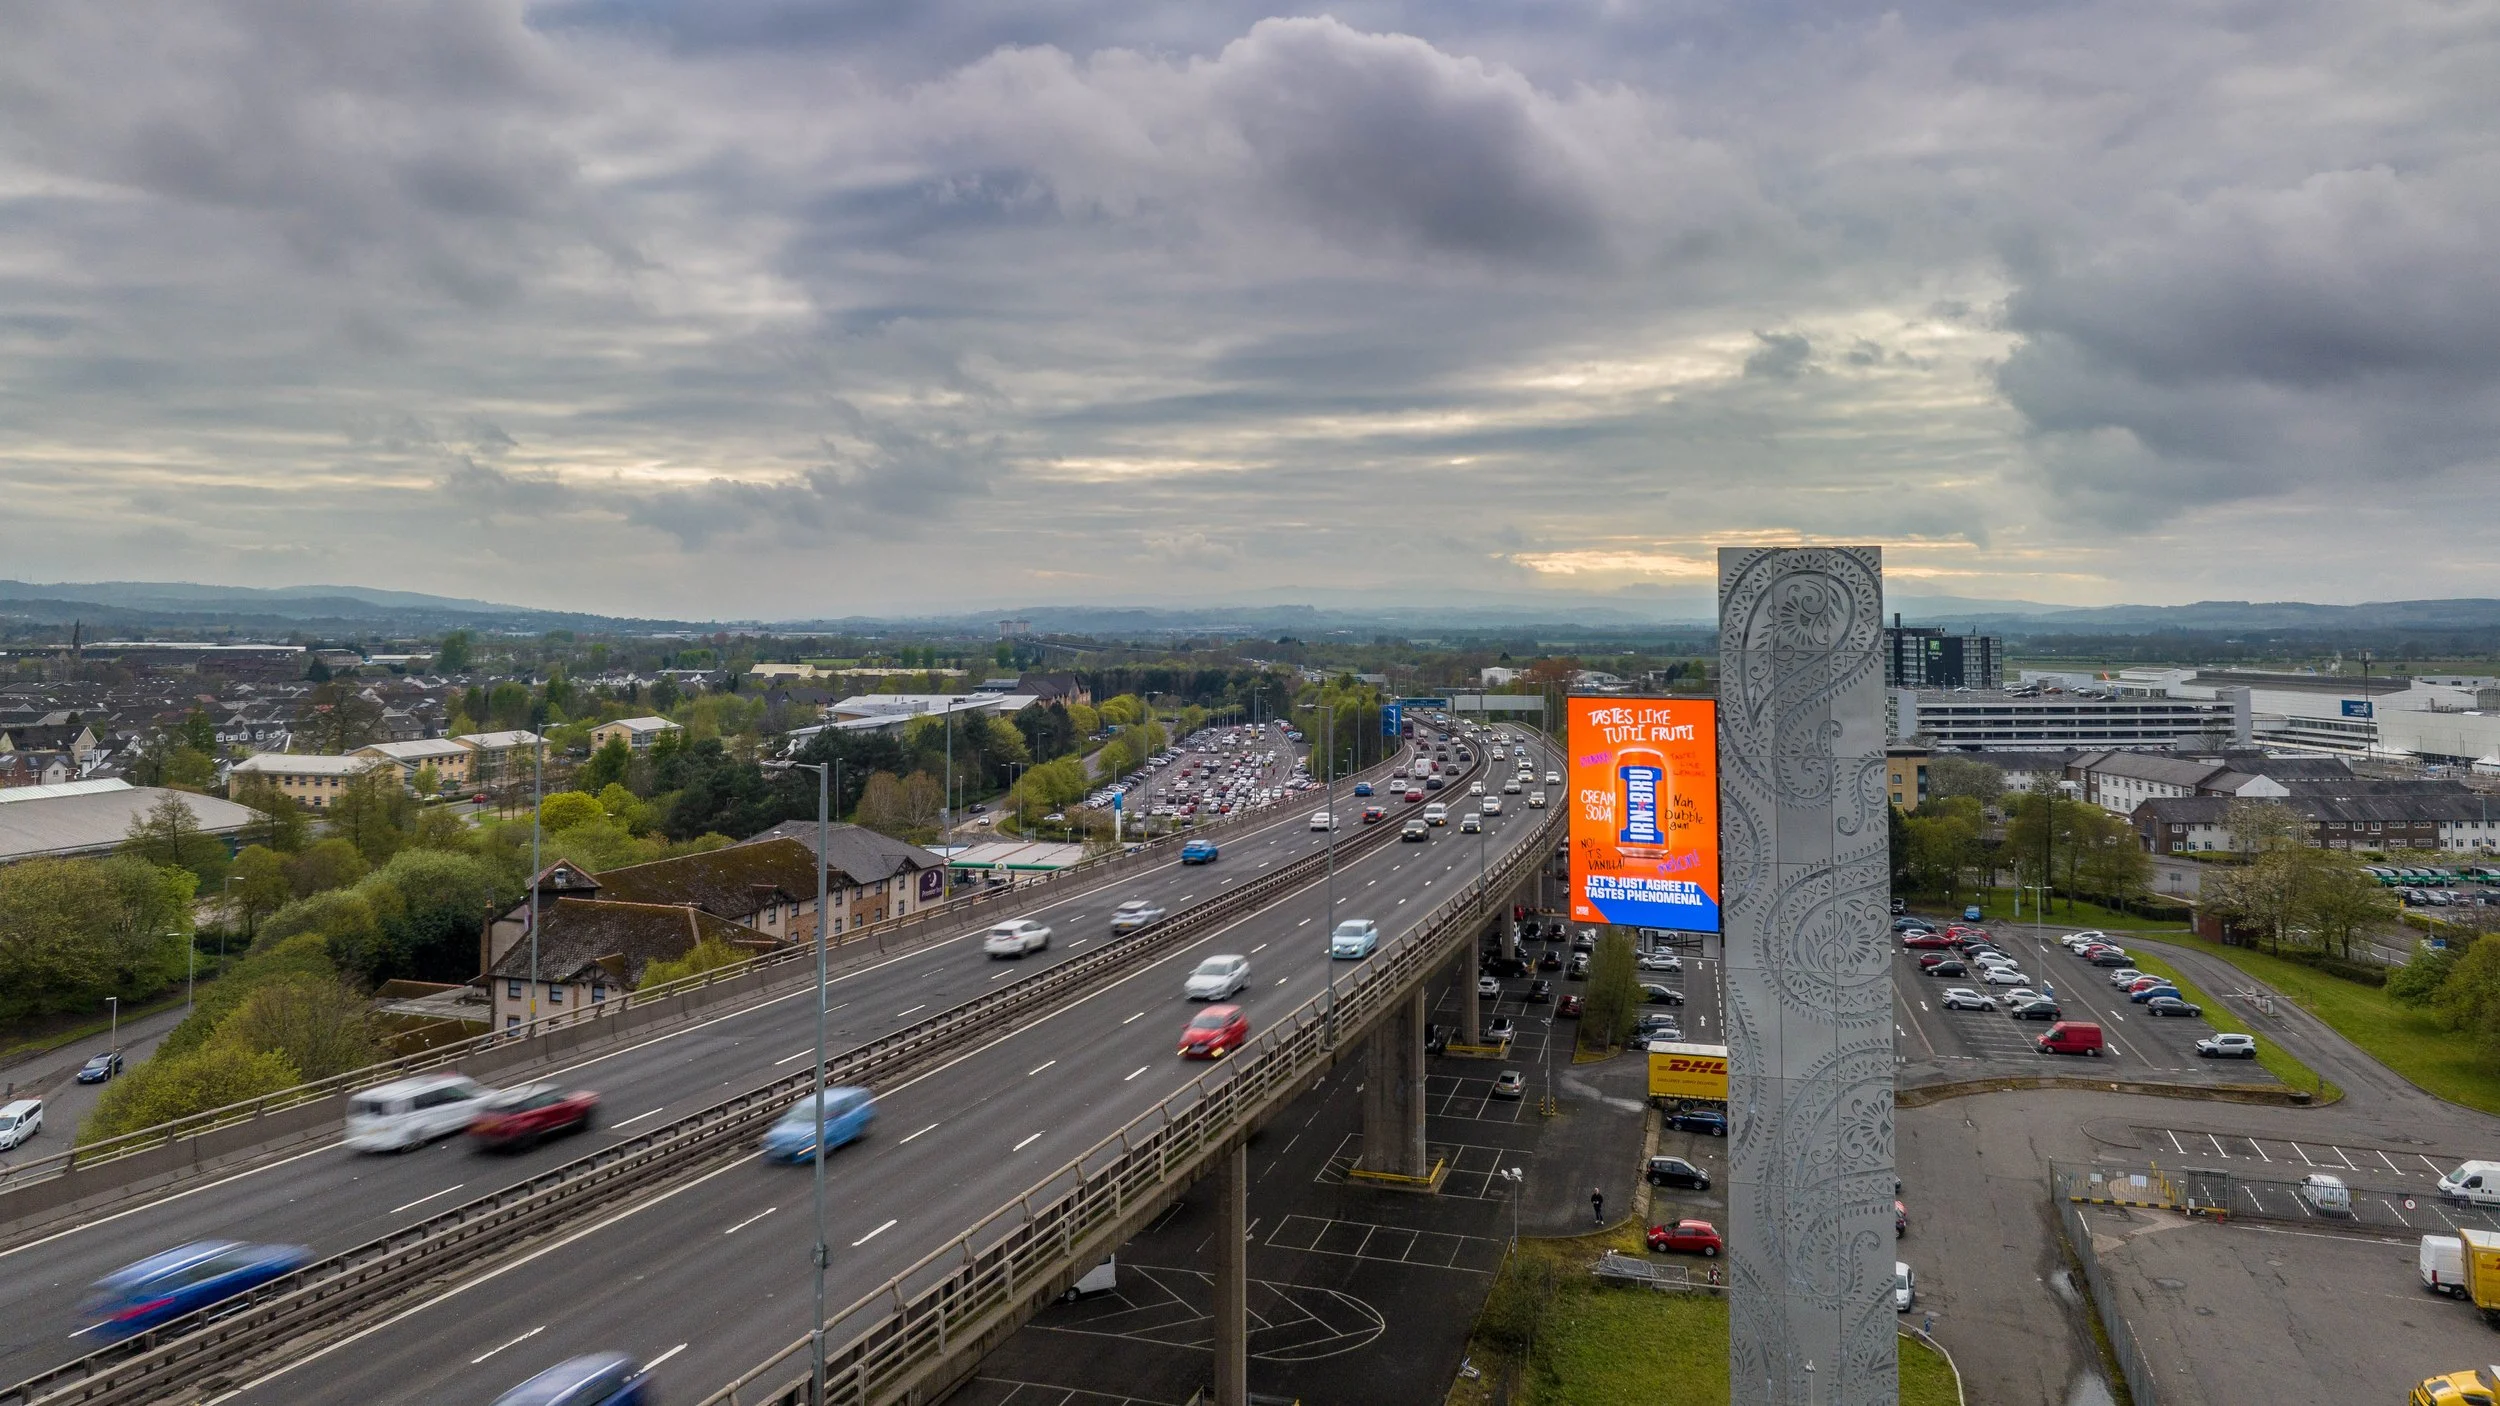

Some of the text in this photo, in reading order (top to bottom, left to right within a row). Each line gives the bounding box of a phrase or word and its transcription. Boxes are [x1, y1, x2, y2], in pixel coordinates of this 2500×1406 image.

[1588, 708, 1671, 726] TASTES LIKE
[1603, 724, 1694, 744] TUTTI FRUTTI
[1580, 789, 1616, 806] CREAM
[1585, 803, 1612, 823] SODA
[1664, 809, 1706, 824] bubble
[1588, 857, 1625, 870] VANILLA!
[1586, 875, 1697, 893] LET'S JUST AGREE IT
[1584, 886, 1703, 906] TASTES PHENOMENAL
[1668, 1059, 1727, 1075] DHL
